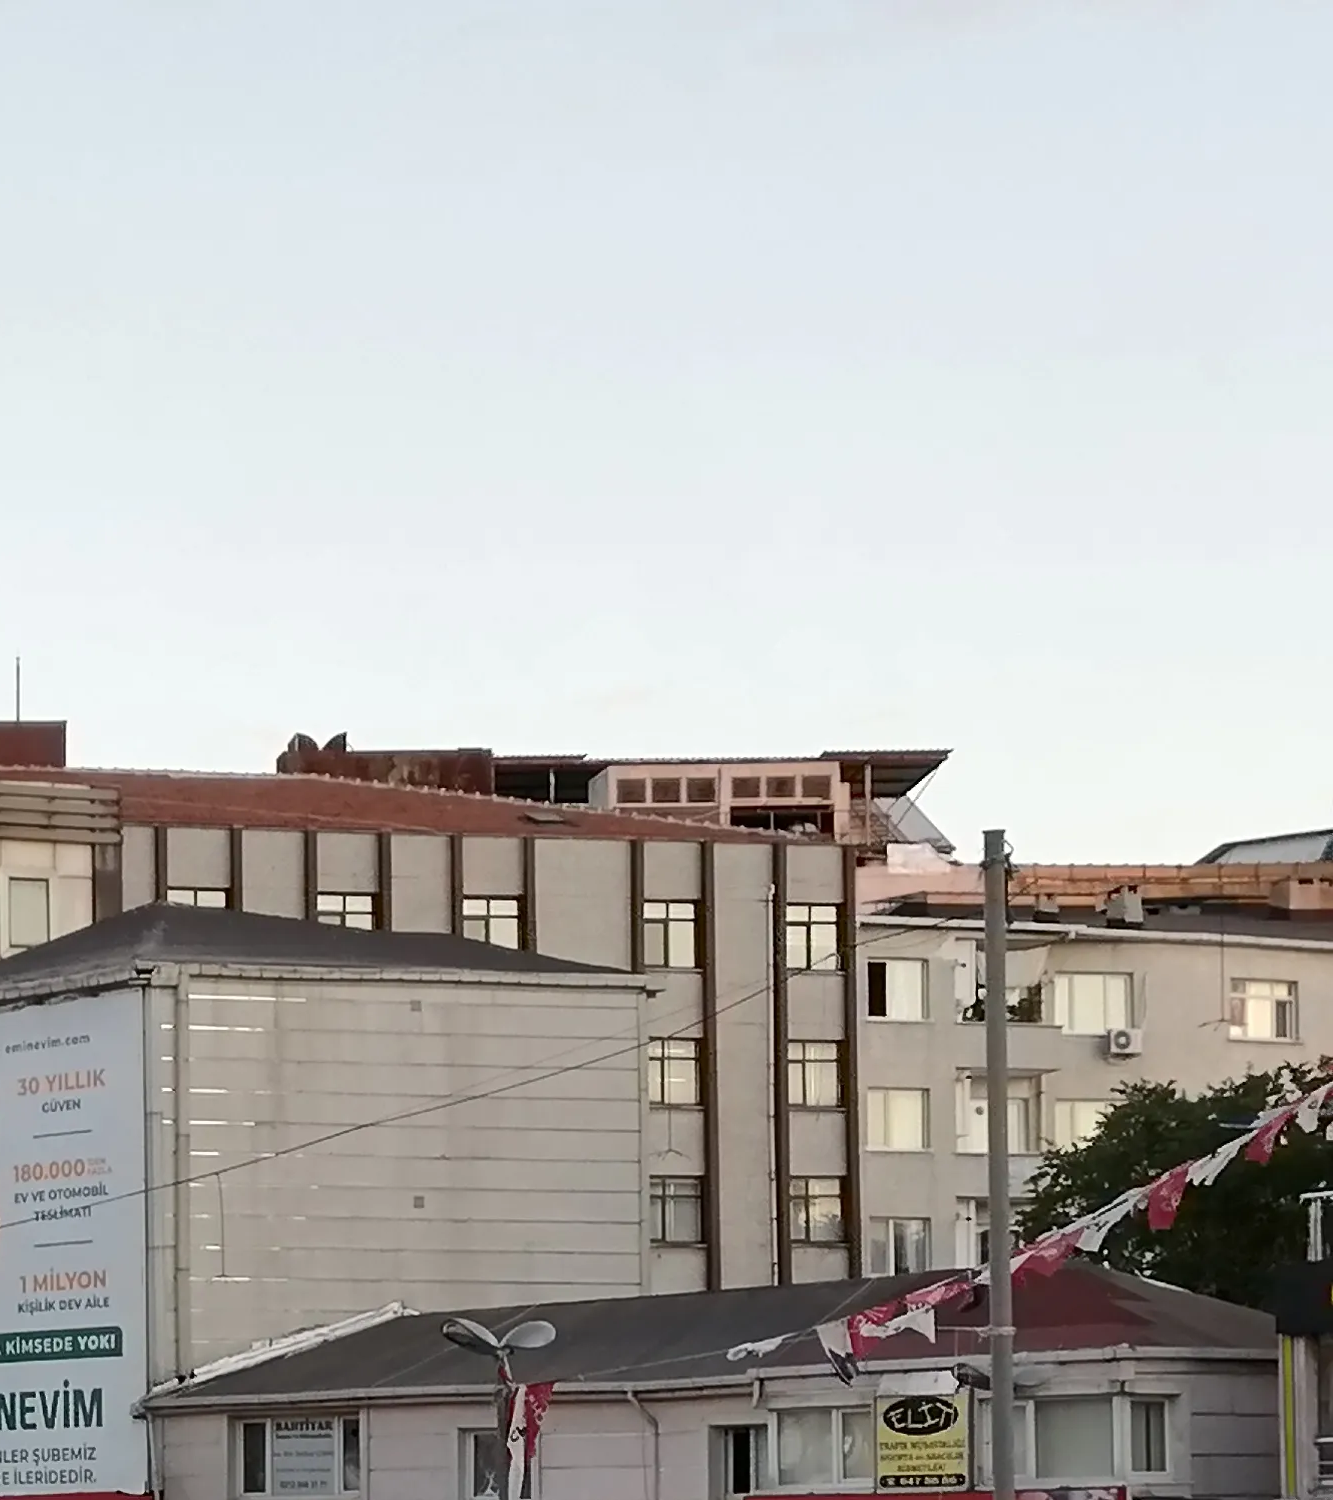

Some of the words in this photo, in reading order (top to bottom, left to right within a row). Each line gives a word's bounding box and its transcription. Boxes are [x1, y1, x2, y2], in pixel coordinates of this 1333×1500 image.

[5, 1034, 90, 1054] eminevim.com
[17, 1077, 40, 1096] 30
[45, 1069, 106, 1092] YILLIK
[42, 1098, 81, 1113] GÜVEN
[13, 1159, 85, 1182] 180.000
[14, 1192, 29, 1204] EV
[31, 1190, 46, 1202] VE
[48, 1181, 109, 1200] OTOMOBİL
[34, 1205, 92, 1221] TESLİMATI
[19, 1275, 28, 1293] 1
[33, 1266, 107, 1292] MİLYON
[17, 1297, 56, 1315] KİŞİLİK
[59, 1298, 82, 1311] DEV
[85, 1294, 110, 1309] AİLE
[5, 1336, 73, 1356] KİMSEDE
[32, 1442, 97, 1466] ŞUBEMİZ
[14, 1466, 97, 1486] İLERİDEDİR.
